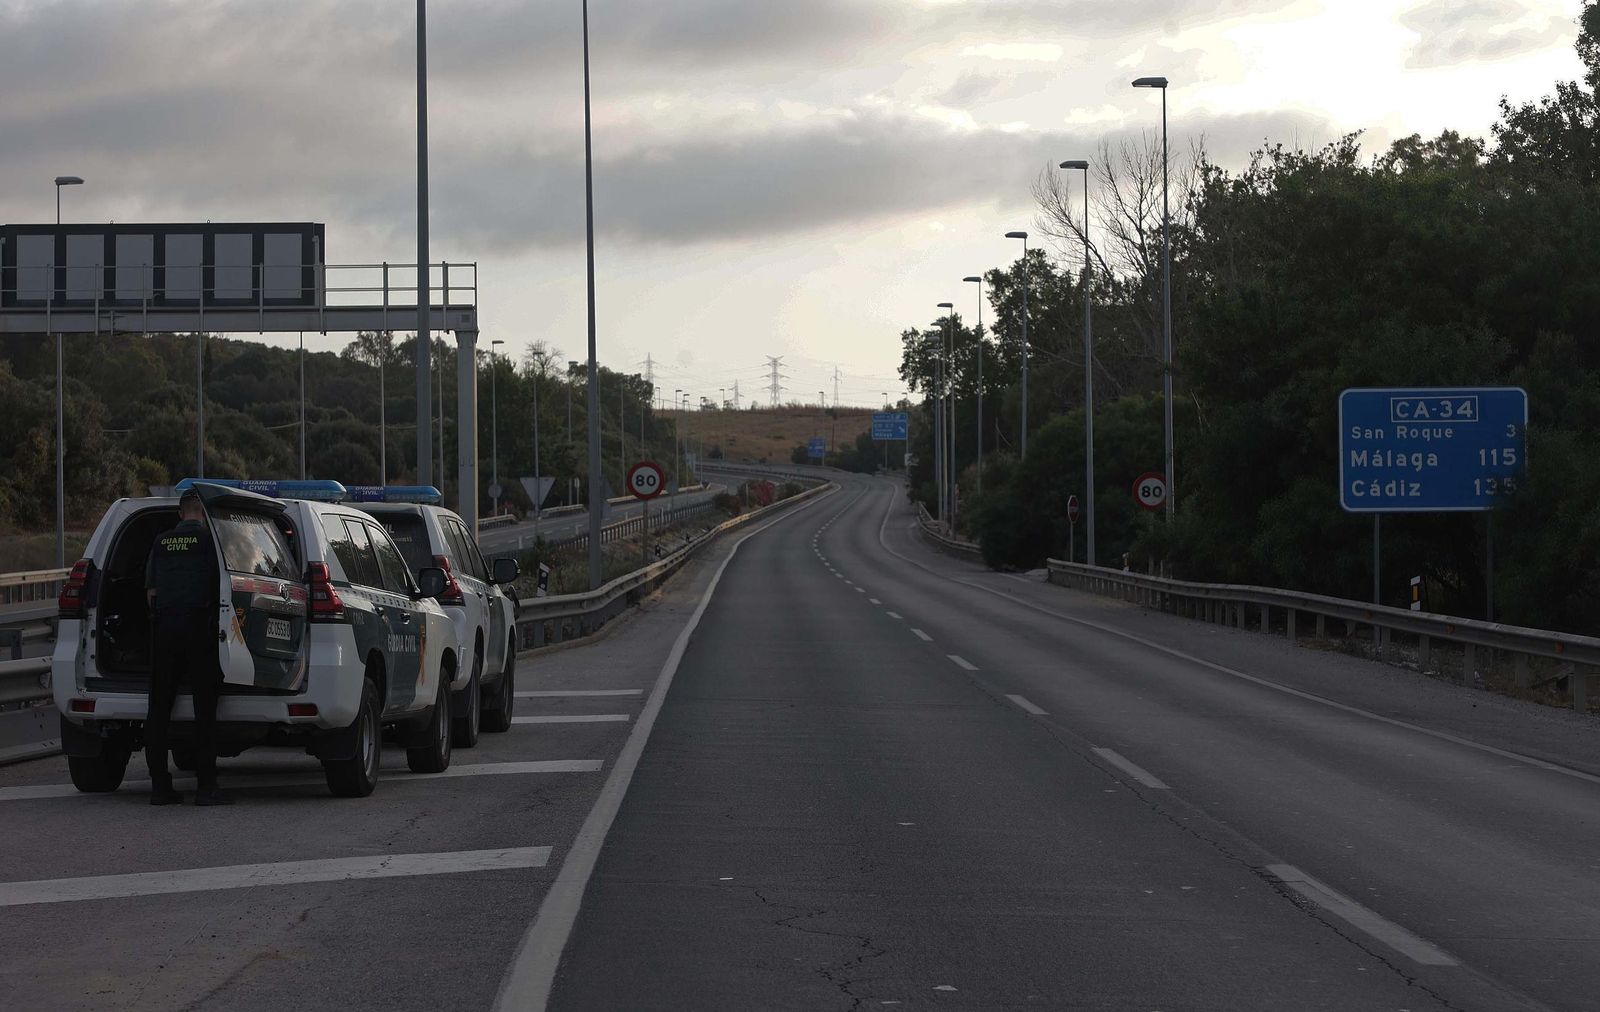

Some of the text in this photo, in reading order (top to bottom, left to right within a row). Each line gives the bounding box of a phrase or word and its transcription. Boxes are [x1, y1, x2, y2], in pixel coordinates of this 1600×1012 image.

[1396, 400, 1473, 418] CA-34
[1351, 424, 1516, 442] San Roque 3
[1351, 448, 1517, 472] Málaga 115
[636, 475, 656, 486] 80
[1351, 478, 1421, 497] Cádiz
[1142, 486, 1162, 498] 80
[160, 537, 199, 545] GUARDIA
[166, 543, 189, 551] CIVIL
[404, 634, 417, 653] CIVIL
